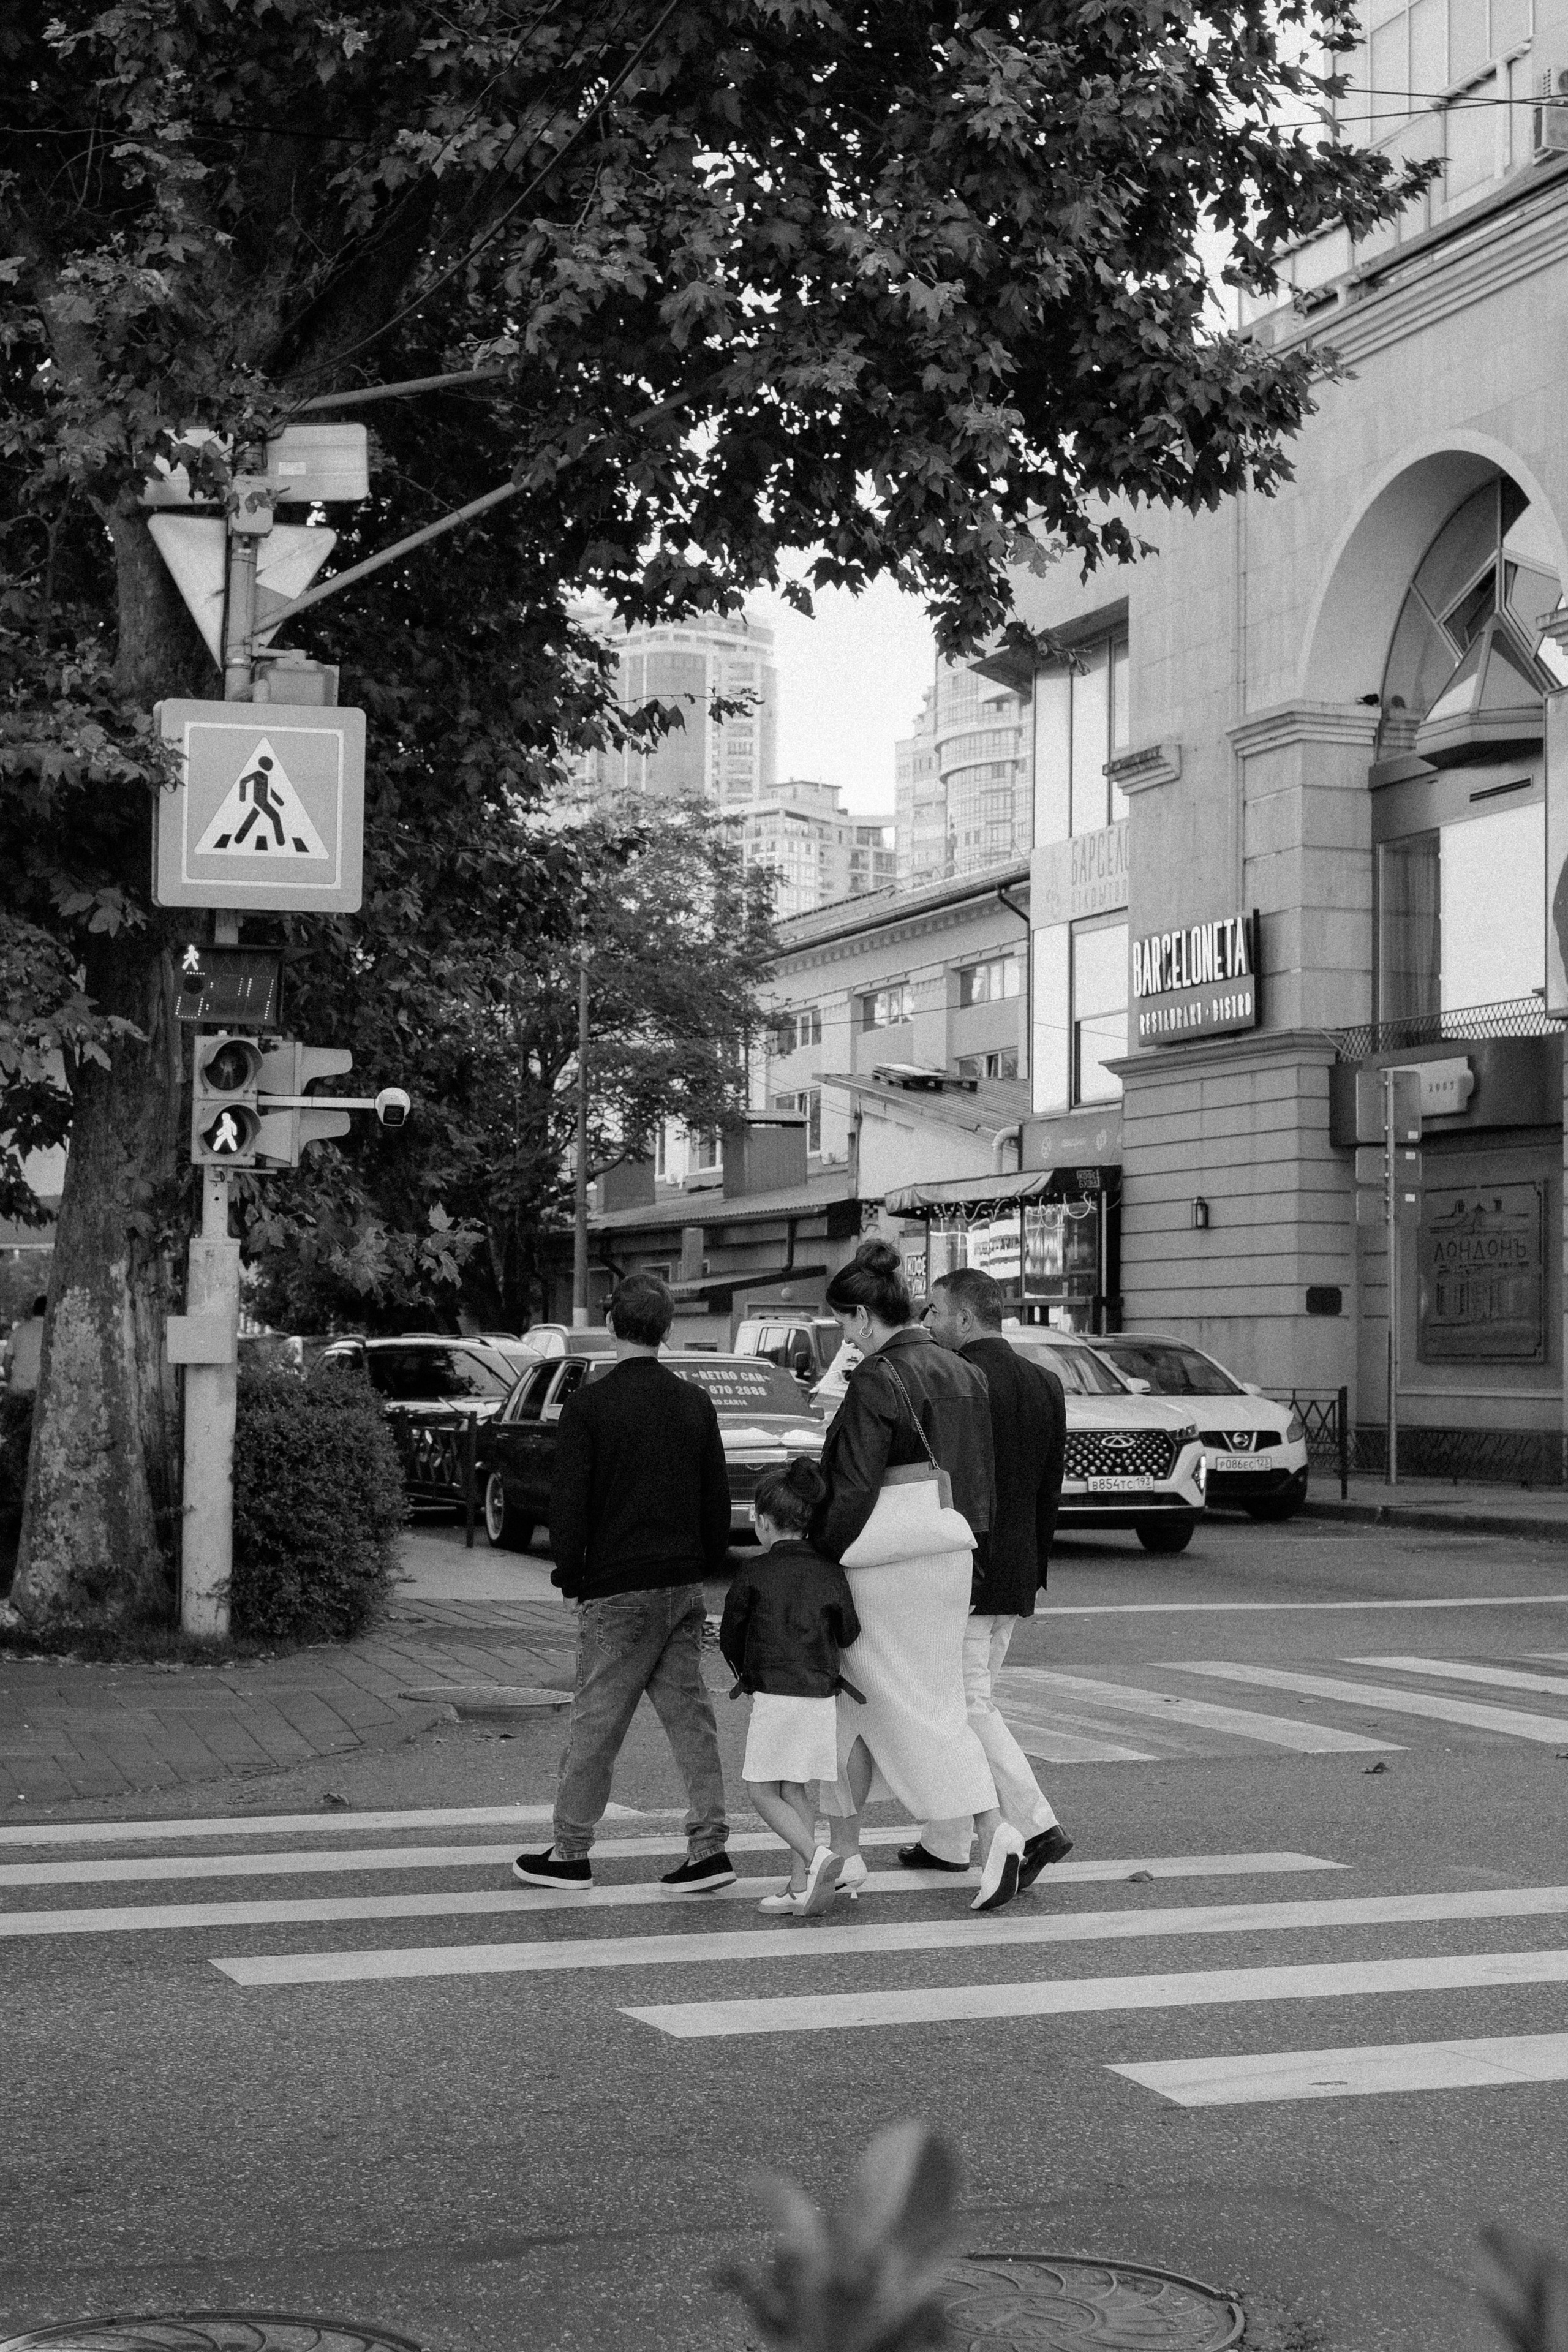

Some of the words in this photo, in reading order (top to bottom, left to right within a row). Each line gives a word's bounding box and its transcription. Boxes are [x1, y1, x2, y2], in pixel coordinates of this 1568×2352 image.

[1133, 916, 1246, 998] BARCELONETA
[1139, 1002, 1202, 1035] RESTAURANT
[1212, 992, 1251, 1022] BISTRO
[1434, 1239, 1526, 1262] ЛОНДОНЪ
[709, 1385, 733, 1394] 870
